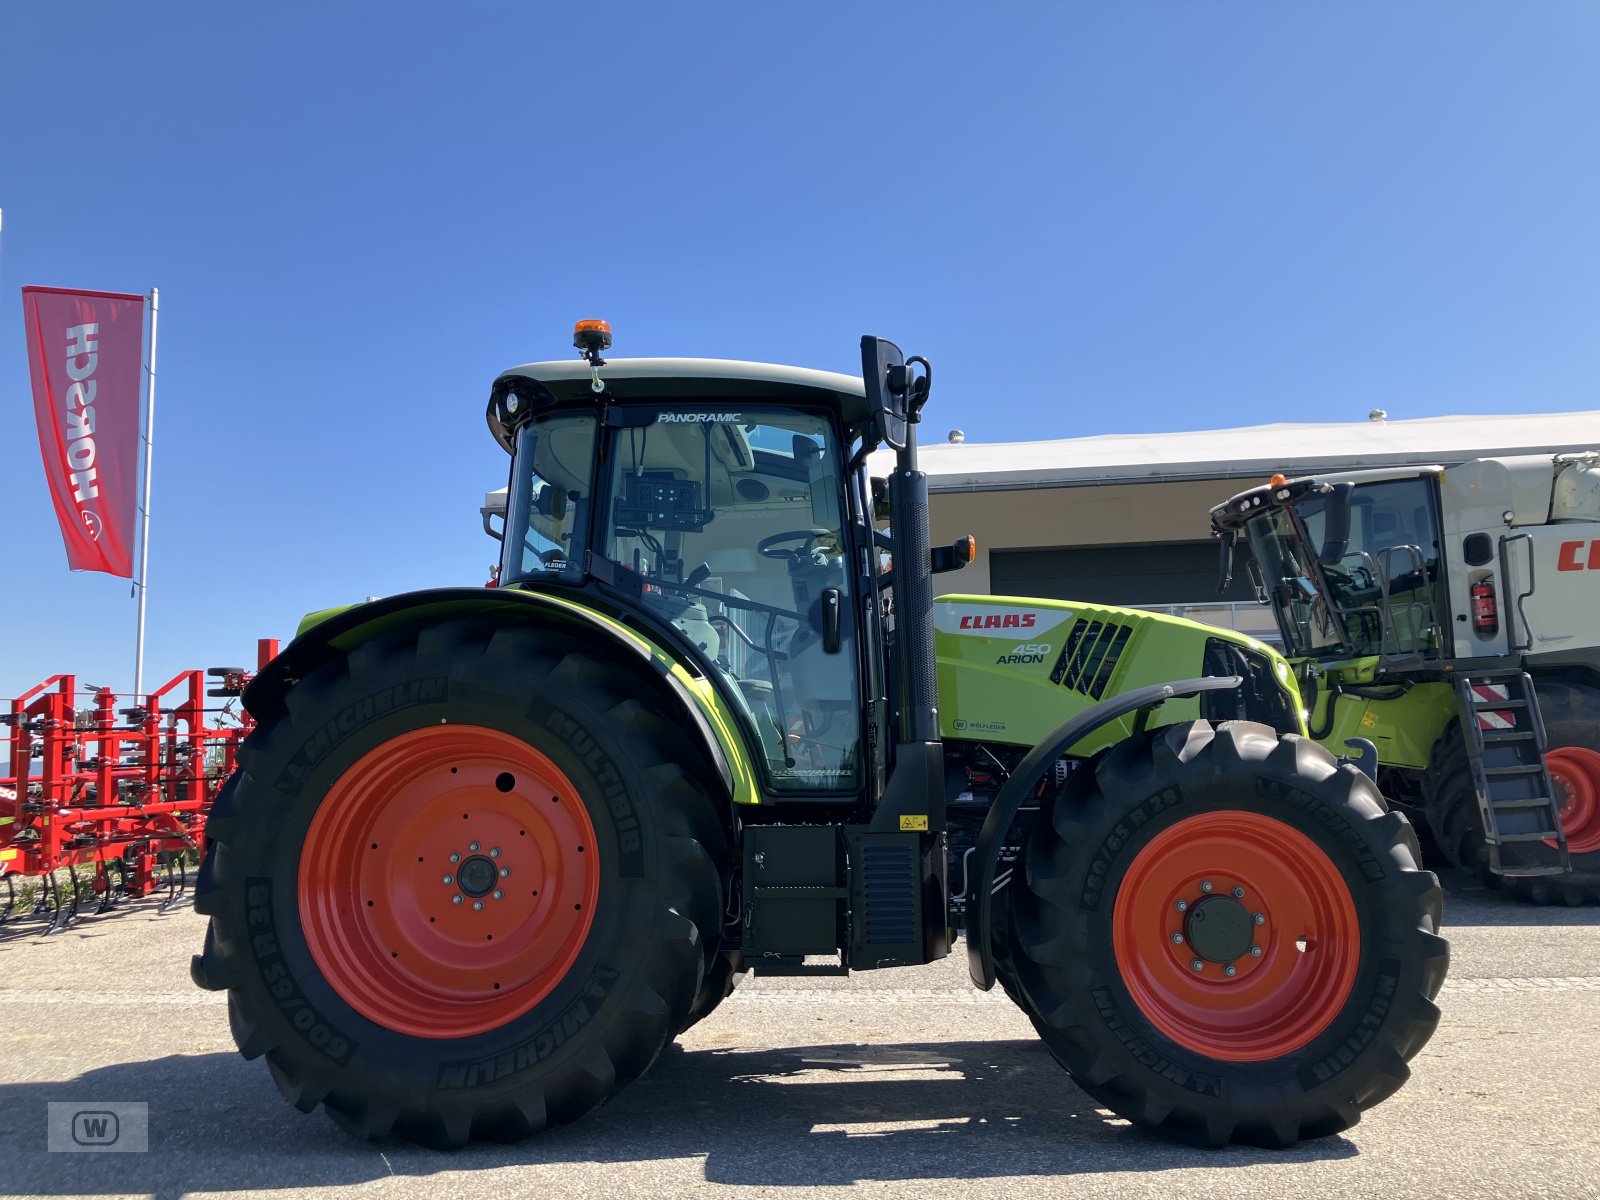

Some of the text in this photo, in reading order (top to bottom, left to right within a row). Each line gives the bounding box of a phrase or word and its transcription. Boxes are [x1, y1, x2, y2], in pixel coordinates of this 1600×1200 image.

[657, 413, 742, 423] PANORAMIC
[959, 613, 1036, 630] CLAAS
[1011, 643, 1053, 655] 450
[995, 654, 1044, 665] ARION
[303, 677, 448, 767] MICHELIN
[545, 708, 641, 853] MULTIBIB
[1129, 807, 1149, 826] R
[1149, 788, 1179, 812] 28
[248, 884, 350, 1059] 600/65 R 38
[437, 1002, 592, 1090] MICHELIN
[1311, 973, 1397, 1081] MULTIBIB
